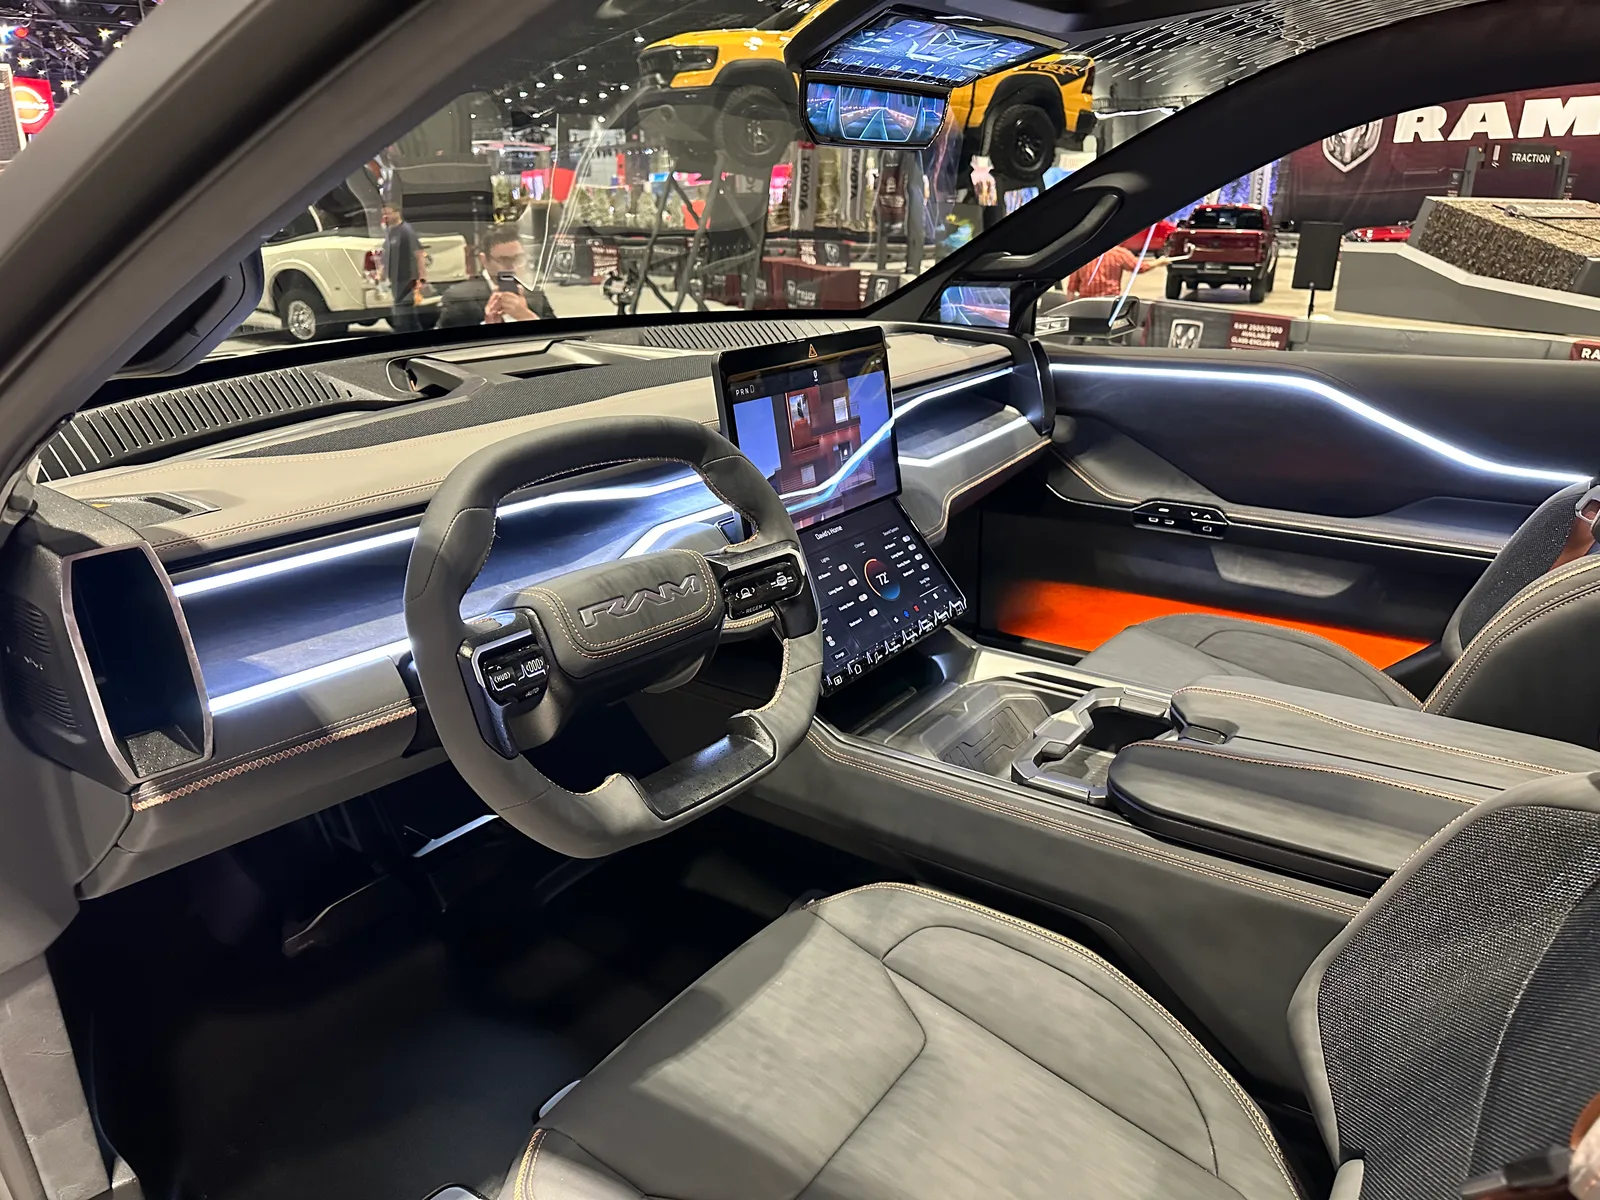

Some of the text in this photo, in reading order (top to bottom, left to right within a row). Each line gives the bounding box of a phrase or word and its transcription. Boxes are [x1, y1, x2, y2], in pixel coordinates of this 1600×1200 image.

[1393, 95, 1600, 144] RAM
[1511, 152, 1551, 164] TRACTION
[800, 155, 811, 211] TOYOTA
[577, 573, 703, 629] RAM
[745, 603, 763, 614] REGEN
